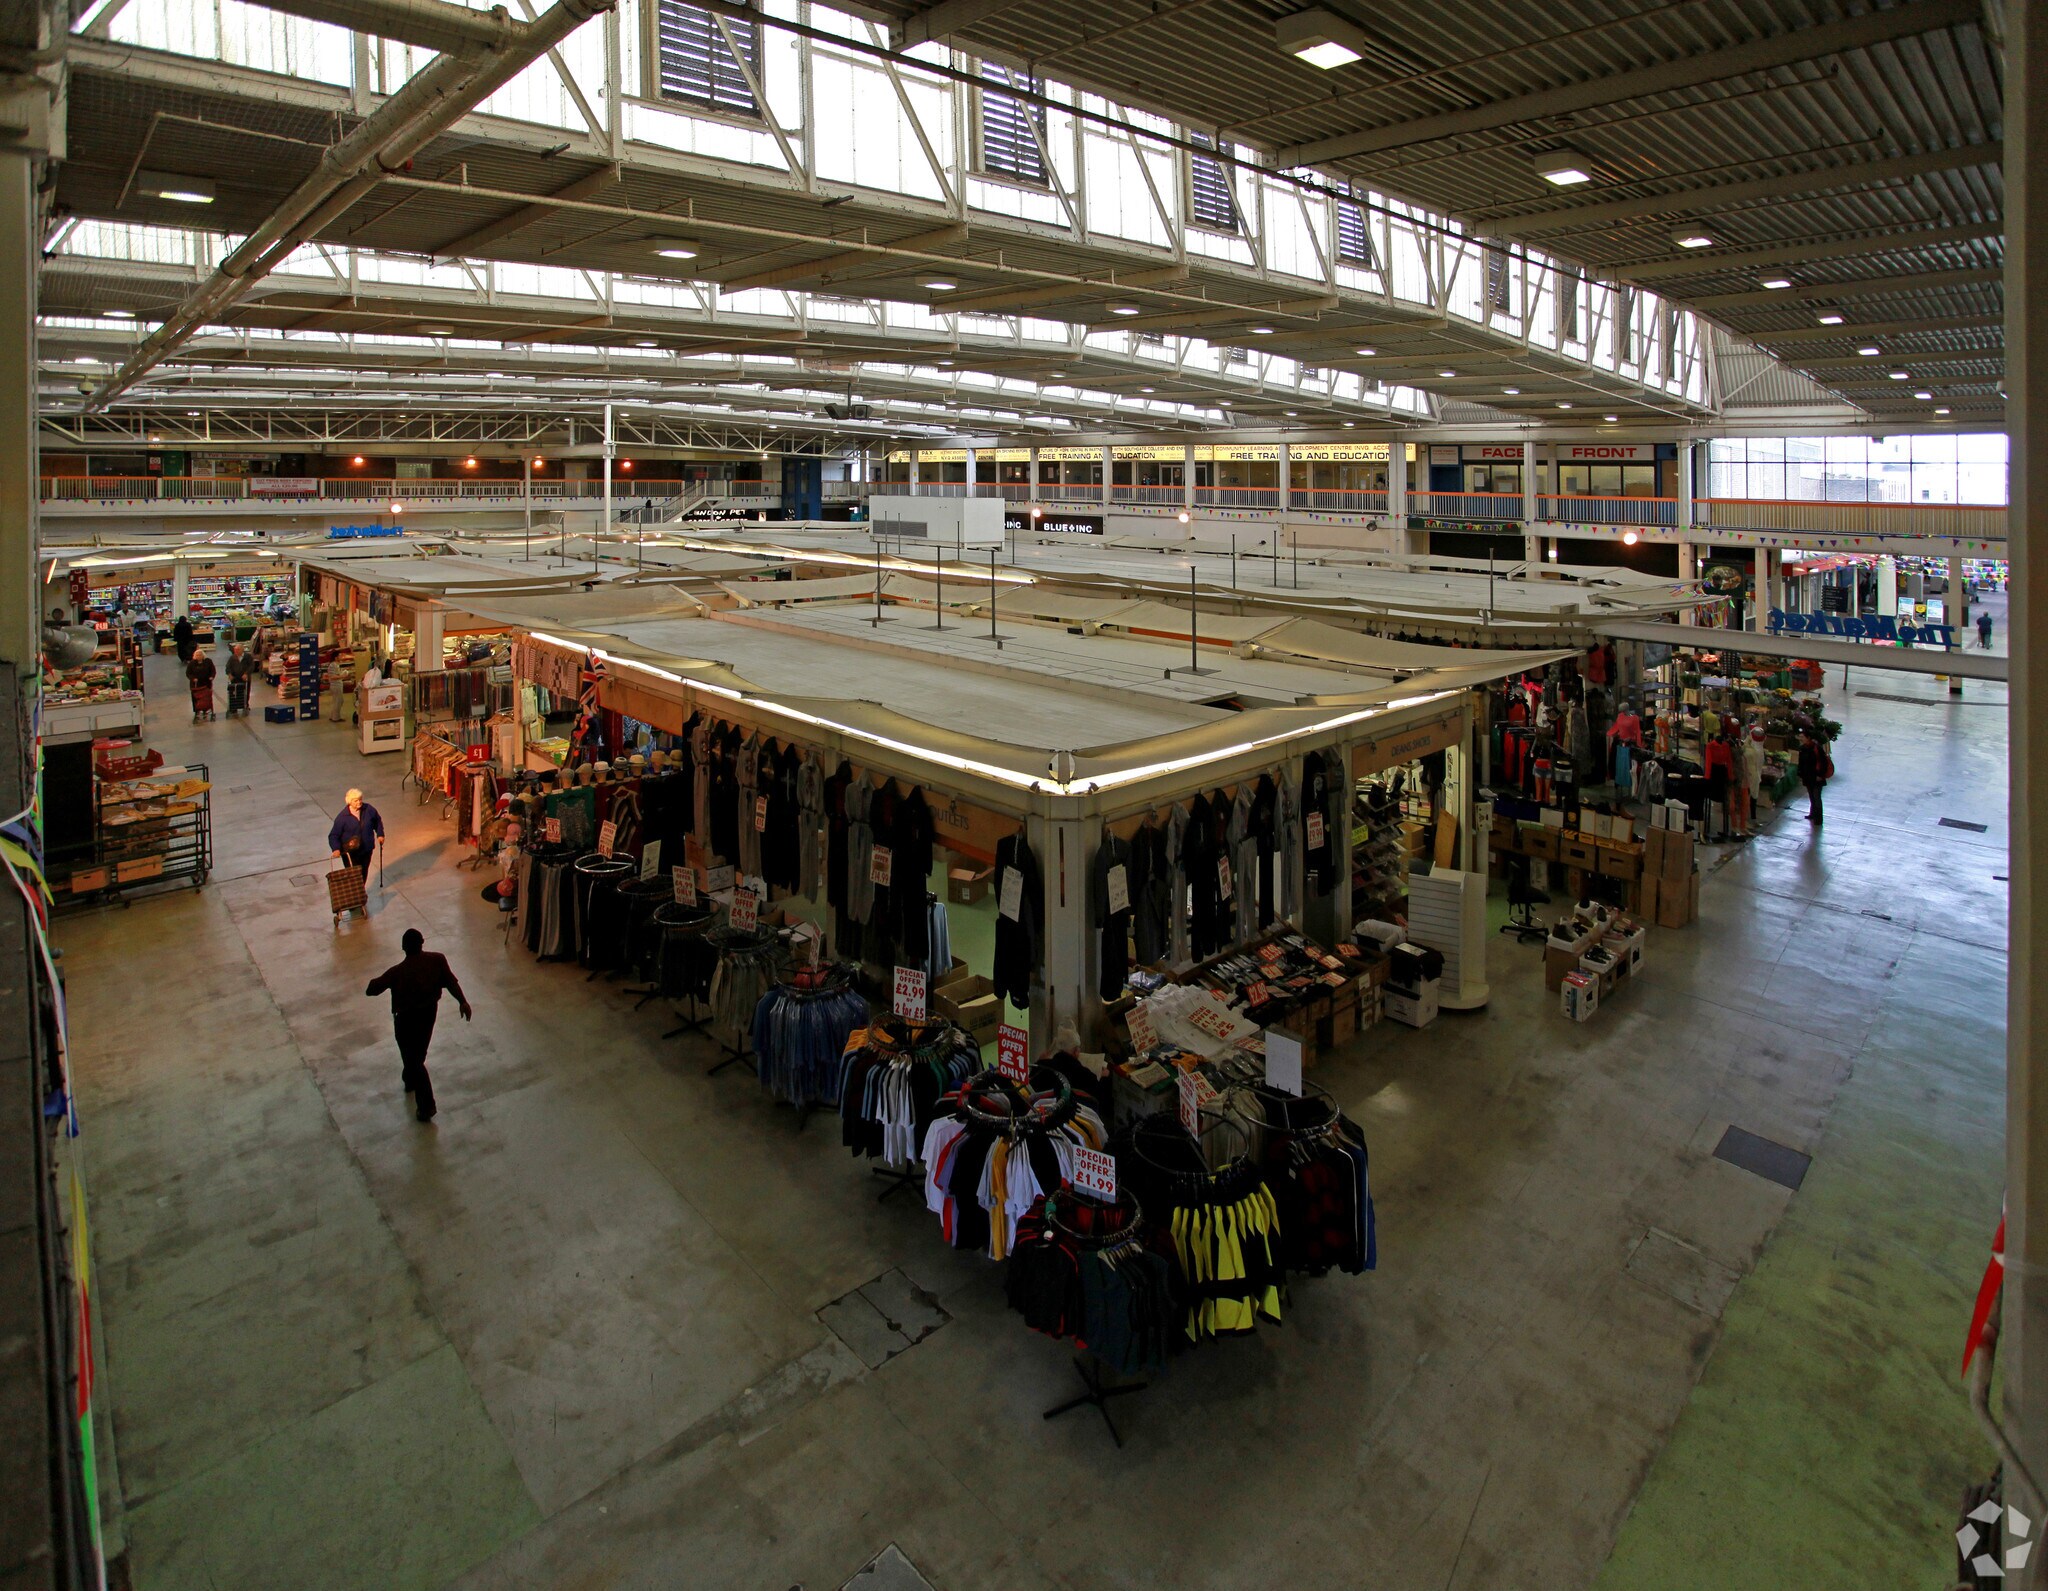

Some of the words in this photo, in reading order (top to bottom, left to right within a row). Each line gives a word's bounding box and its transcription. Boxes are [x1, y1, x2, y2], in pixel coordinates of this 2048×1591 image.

[1306, 452, 1329, 460] AND
[1482, 447, 1524, 458] FACE
[1572, 447, 1637, 458] FRONT
[1006, 521, 1022, 529] INC
[1043, 522, 1068, 532] BLUE
[1076, 524, 1093, 533] INC
[473, 748, 484, 759] £1
[874, 853, 889, 863] OFFER
[676, 888, 692, 896] ONLY
[733, 888, 756, 900] SPECIAL
[735, 898, 754, 909] OFFER
[731, 908, 756, 921] £4.99
[895, 968, 925, 979] SPECIAL
[899, 975, 921, 985] OFFER
[895, 983, 925, 999] £2.99
[895, 1002, 900, 1013] 2
[902, 1002, 912, 1016] for
[914, 1006, 924, 1019] £5
[1188, 1005, 1207, 1021] SPECIAL
[1194, 1009, 1213, 1024] OFFER
[1201, 1013, 1219, 1029] £1.99
[998, 1025, 1026, 1042] SPECIAL
[1219, 1023, 1236, 1038] £5
[1001, 1038, 1024, 1054] OFFER
[999, 1064, 1027, 1082] ONLY
[1075, 1147, 1113, 1168] SPECIAL
[1080, 1159, 1109, 1177] OFFER
[1075, 1170, 1114, 1193] £1.99
